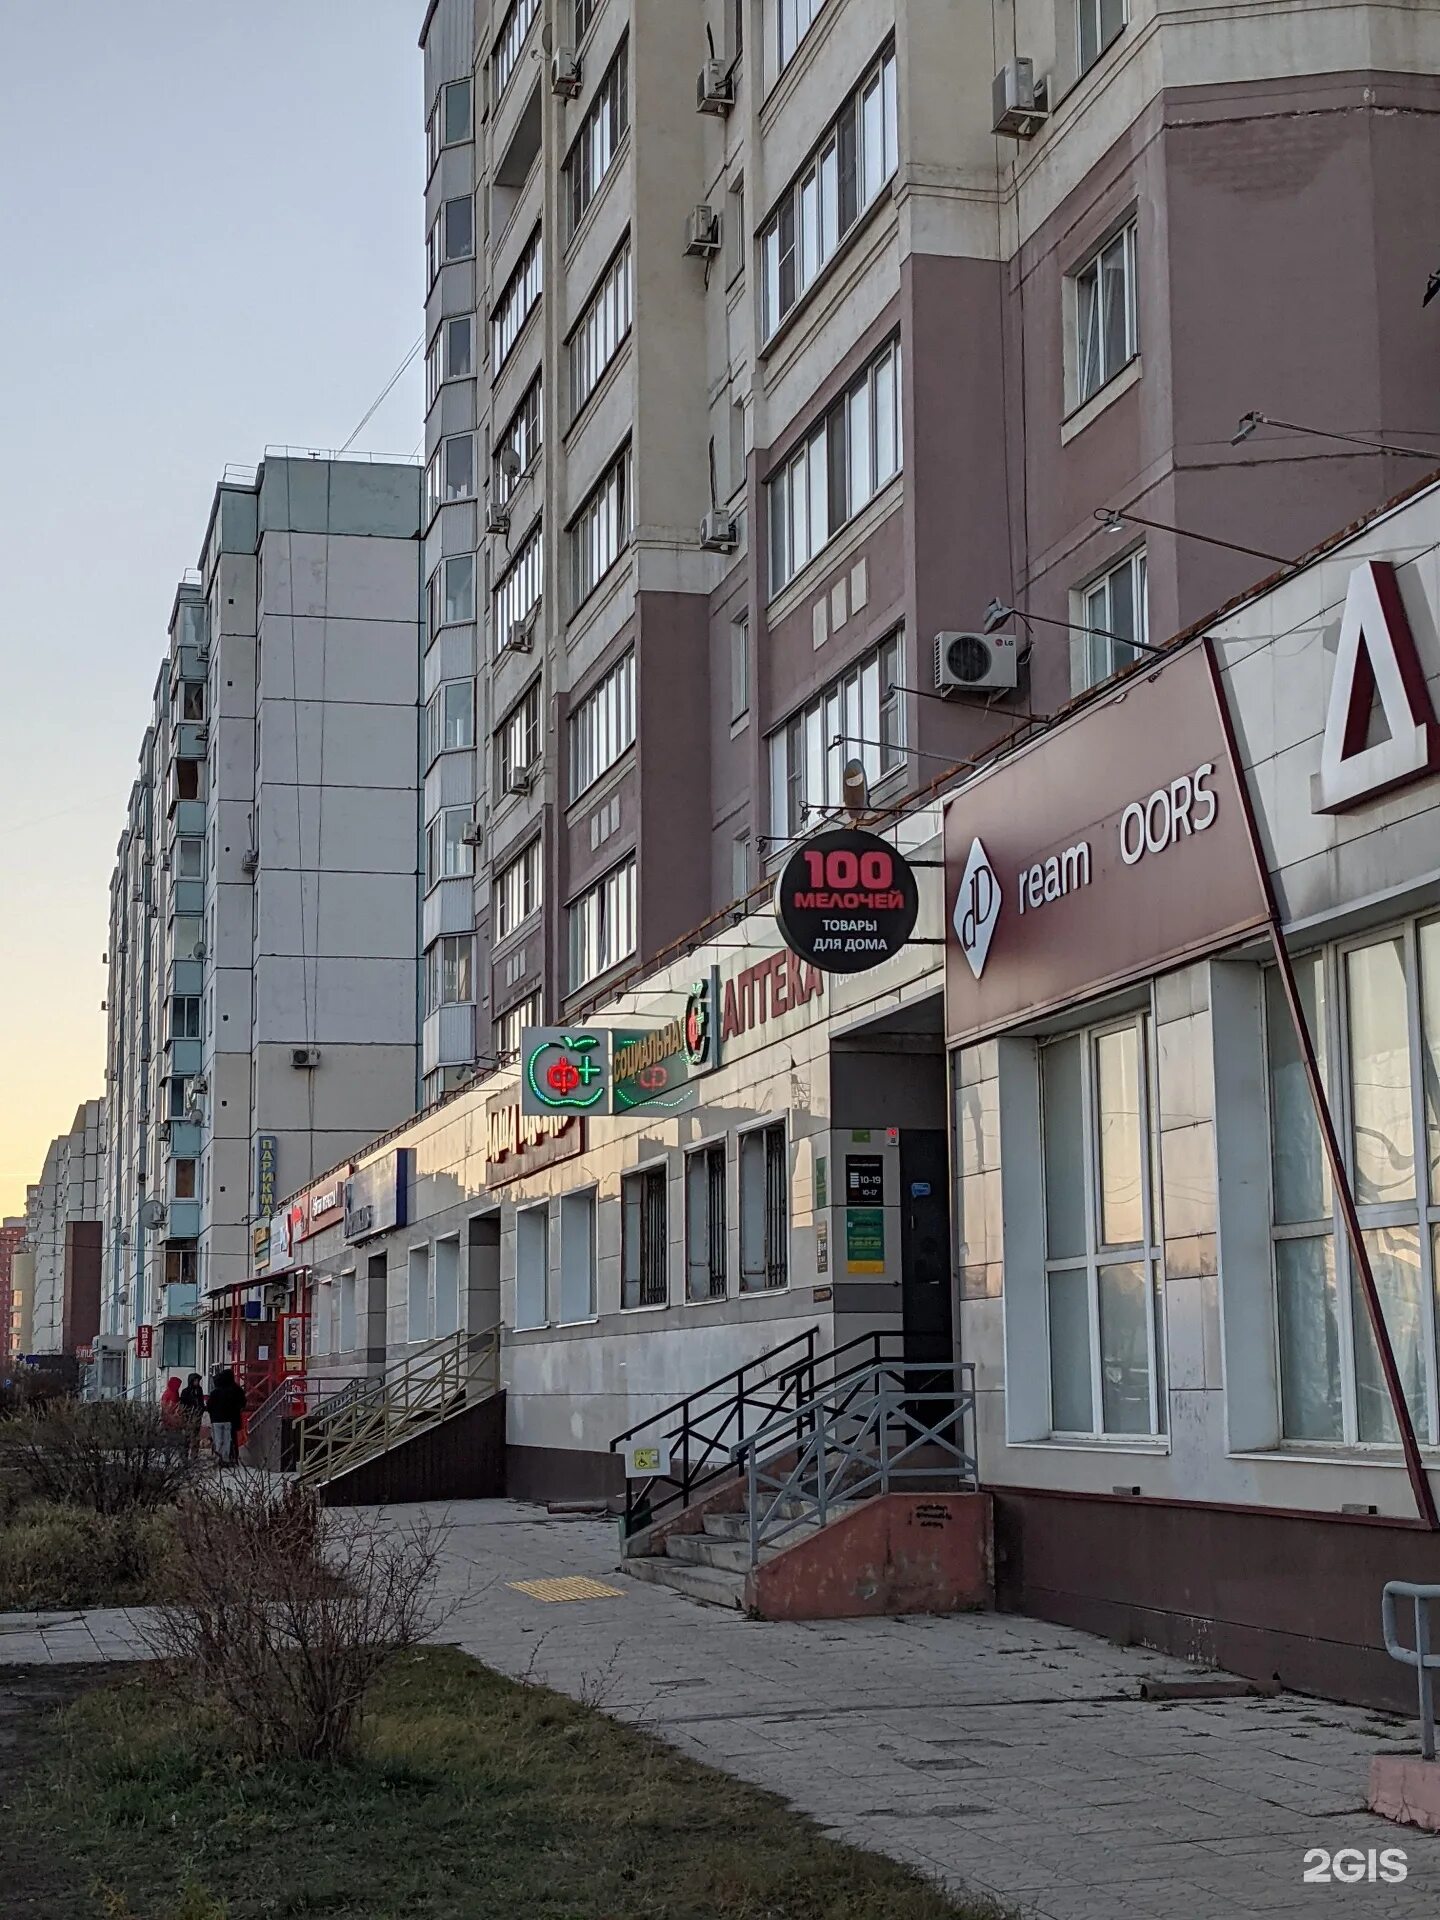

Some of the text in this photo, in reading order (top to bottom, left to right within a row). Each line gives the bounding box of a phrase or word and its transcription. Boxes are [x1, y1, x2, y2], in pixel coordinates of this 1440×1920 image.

[1004, 639, 1014, 647] LG
[1018, 841, 1091, 915] ream
[1120, 763, 1216, 866] OORS
[804, 851, 893, 889] 100
[794, 890, 904, 909] МЕЛОЧЕЙ
[822, 919, 877, 932] ТОВАРЫ
[813, 938, 888, 952] ДЛЯ ДОМА
[721, 946, 824, 1043] АПТЕКА
[261, 1139, 275, 1217] ПАРИКМА
[860, 1175, 881, 1184] 10-19
